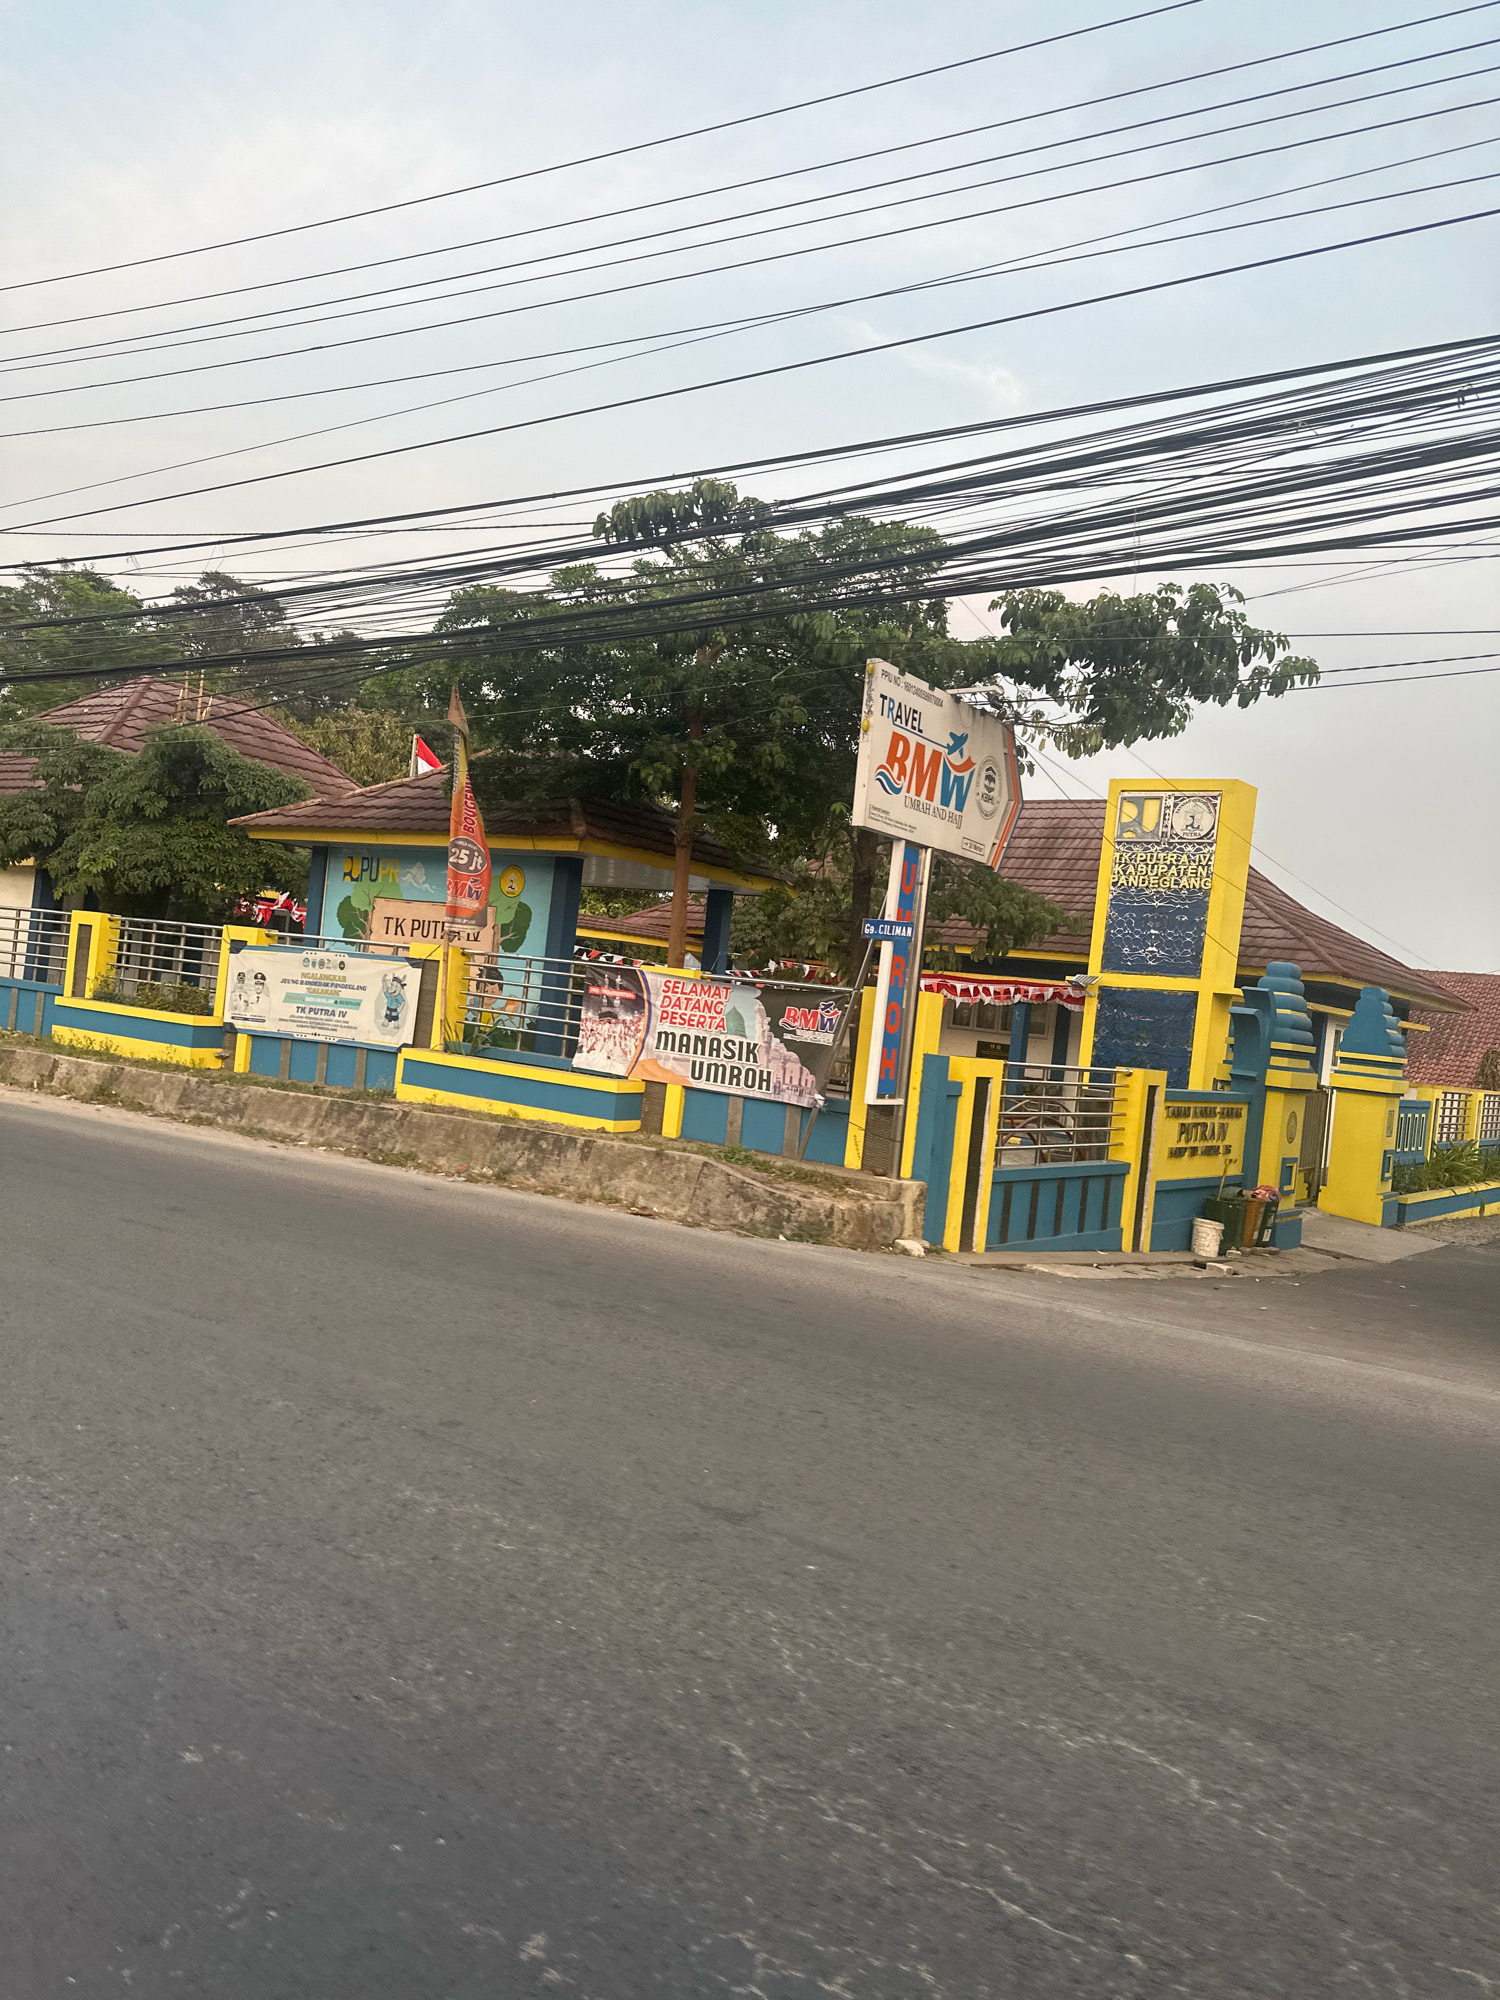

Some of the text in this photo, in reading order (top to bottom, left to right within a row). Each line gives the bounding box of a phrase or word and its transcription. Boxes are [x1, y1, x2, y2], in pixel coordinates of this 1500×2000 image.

[880, 693, 923, 734] TRAVEL
[884, 731, 976, 813] BMW
[904, 796, 931, 816] UMRAH
[931, 805, 947, 821] AND
[947, 811, 963, 829] HAJJ
[361, 856, 400, 883] PUPR
[449, 848, 483, 871] 25 jt
[1115, 852, 1210, 866] TK PUTRA IV
[1114, 863, 1208, 877] KABUPATEN
[1110, 875, 1212, 889] PANDEGLANG
[384, 917, 406, 937] TK
[878, 924, 912, 938] CILIMAN
[661, 979, 731, 1000] SELAMAT
[296, 1006, 347, 1018] TK PUTRA IV
[660, 997, 724, 1015] DATANG
[658, 1010, 727, 1032] PESERTA
[784, 1006, 841, 1033] BMW
[655, 1030, 760, 1065] MANASIK
[690, 1059, 773, 1094] UMROH
[1177, 1122, 1216, 1143] PUTRA
